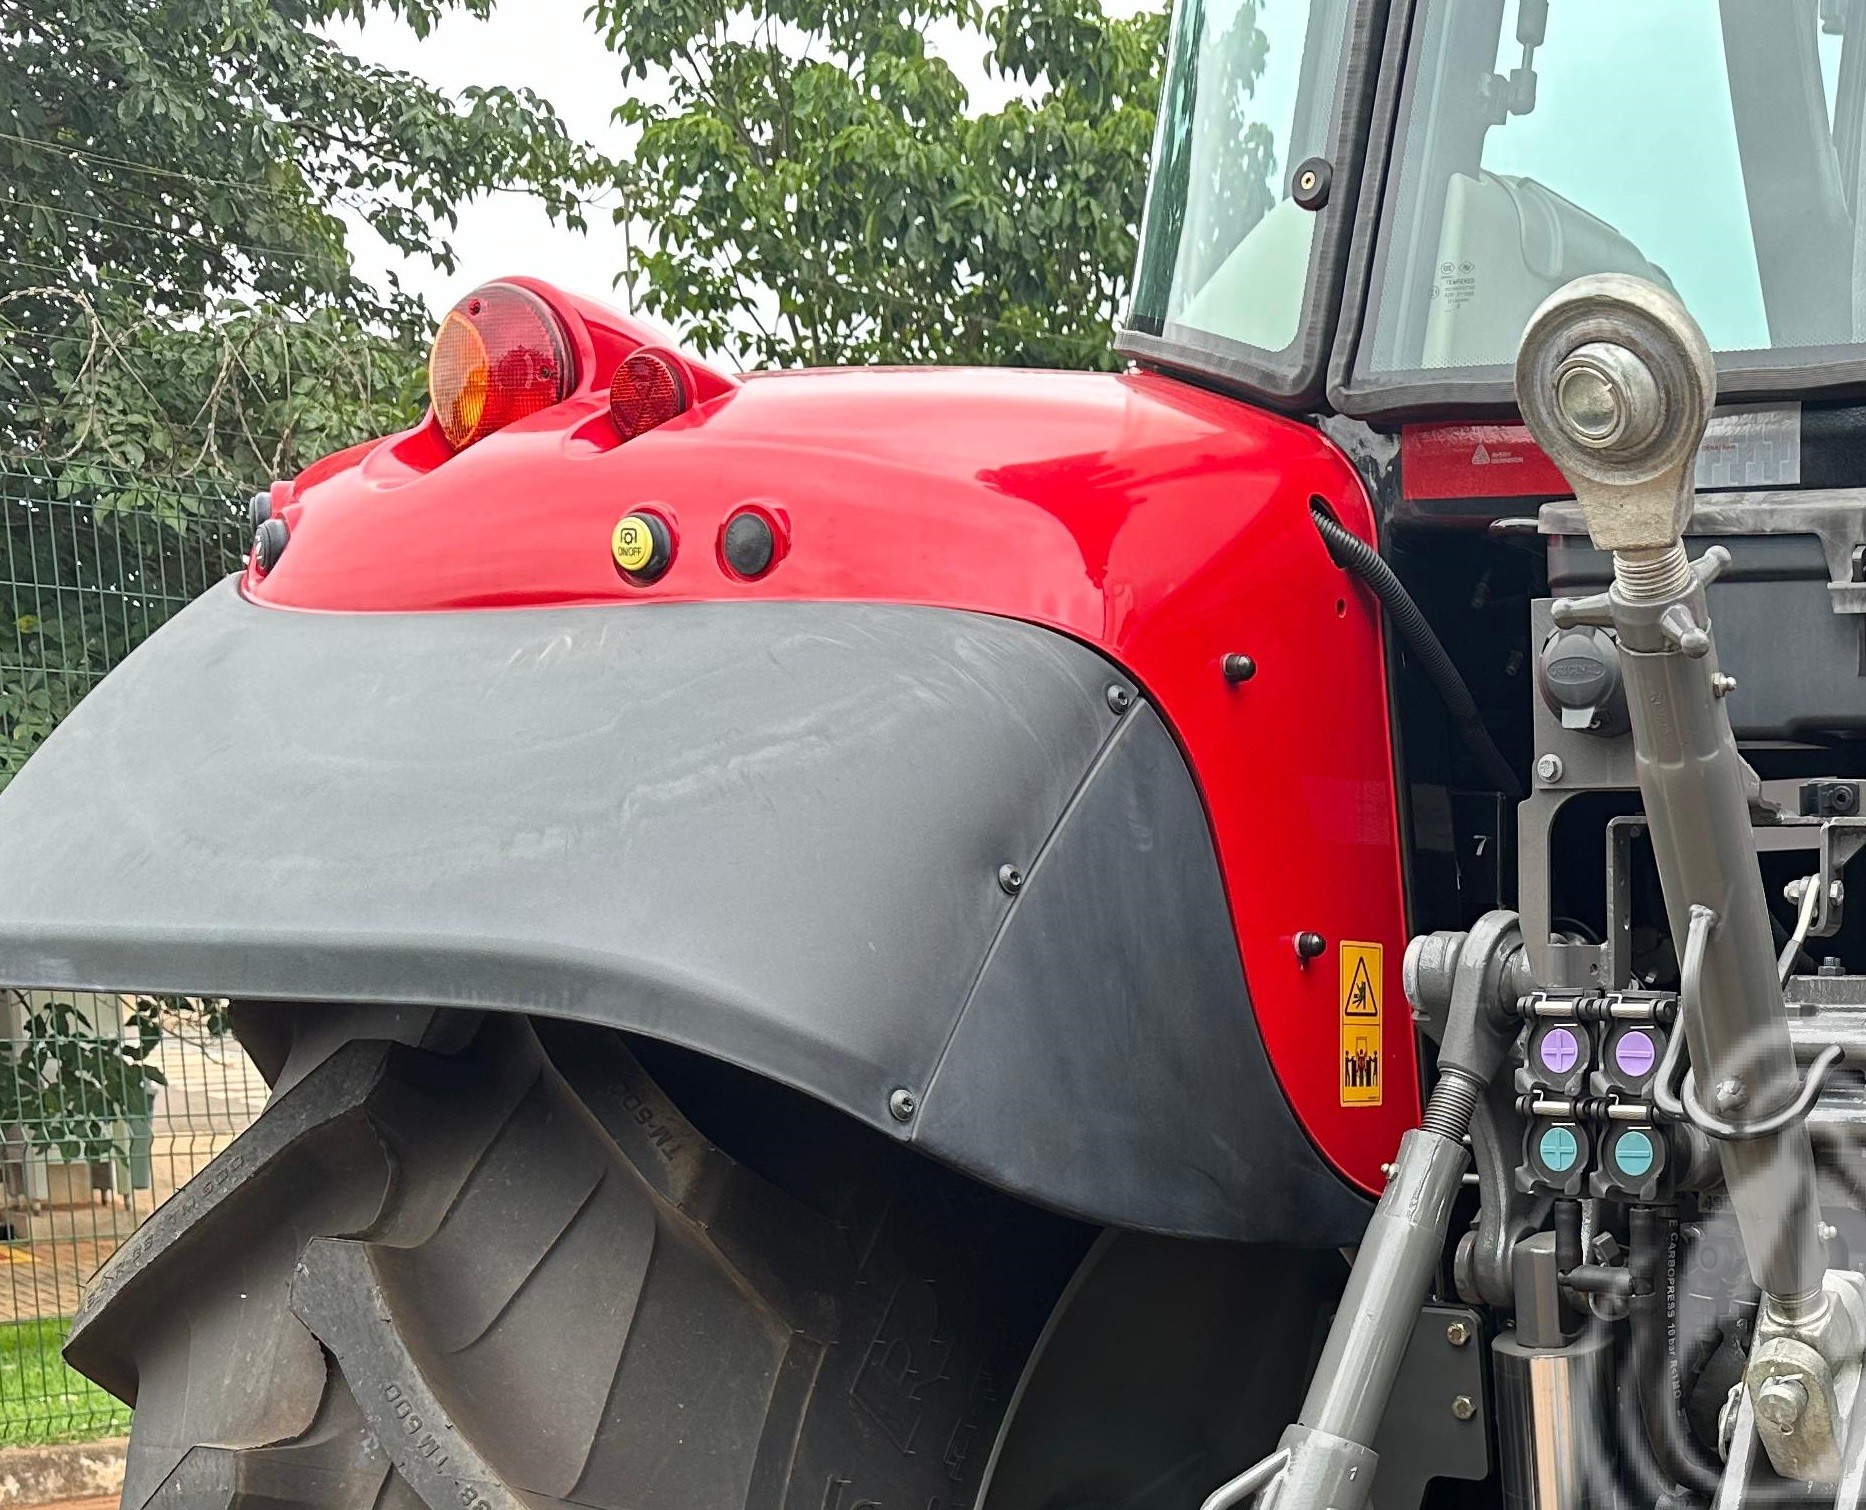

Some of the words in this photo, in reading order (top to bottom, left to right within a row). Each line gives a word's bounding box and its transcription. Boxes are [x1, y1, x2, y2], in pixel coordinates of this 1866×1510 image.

[617, 546, 642, 557] ON/OFF
[1666, 1233, 1679, 1319] CARBOPRESS
[1667, 1337, 1676, 1357] bar
[384, 1383, 423, 1436] 600
[417, 1433, 449, 1475] TM
